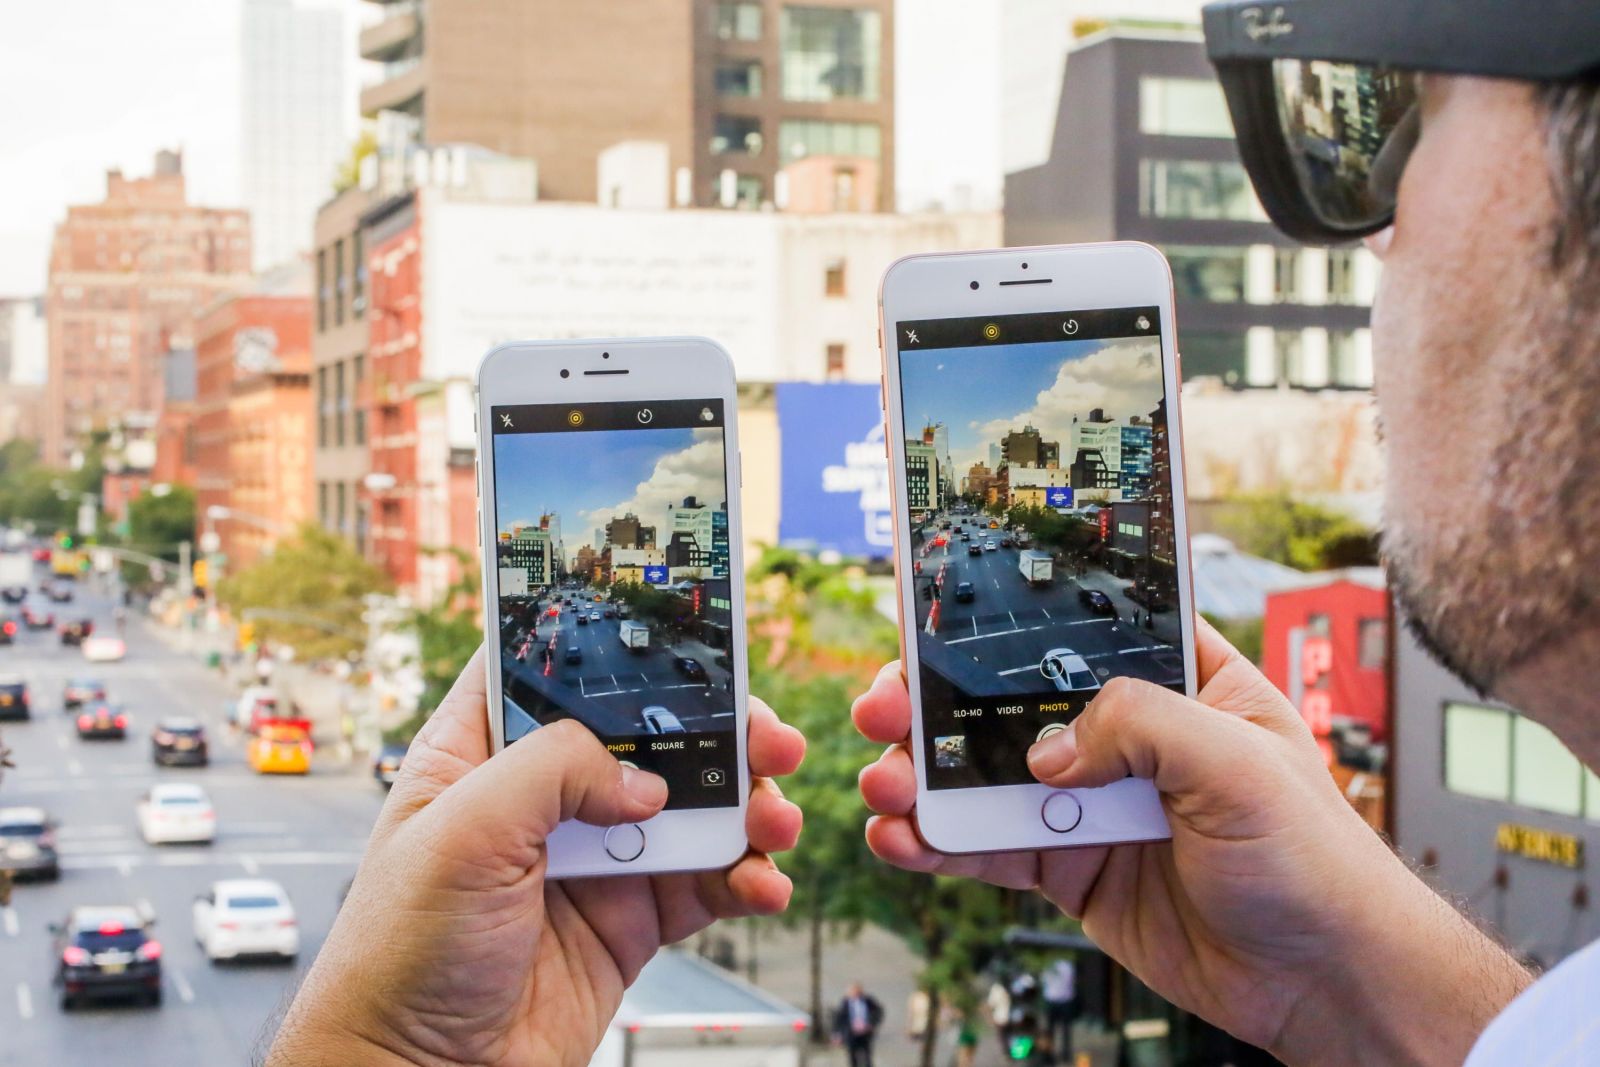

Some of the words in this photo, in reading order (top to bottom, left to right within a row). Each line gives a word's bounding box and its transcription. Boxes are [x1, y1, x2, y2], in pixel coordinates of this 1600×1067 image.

[953, 709, 982, 717] SLO-MO
[997, 706, 1024, 715] VIDEO
[1040, 703, 1069, 711] PHOTO
[607, 744, 636, 752] PHOTO
[651, 742, 685, 750] SQUARE
